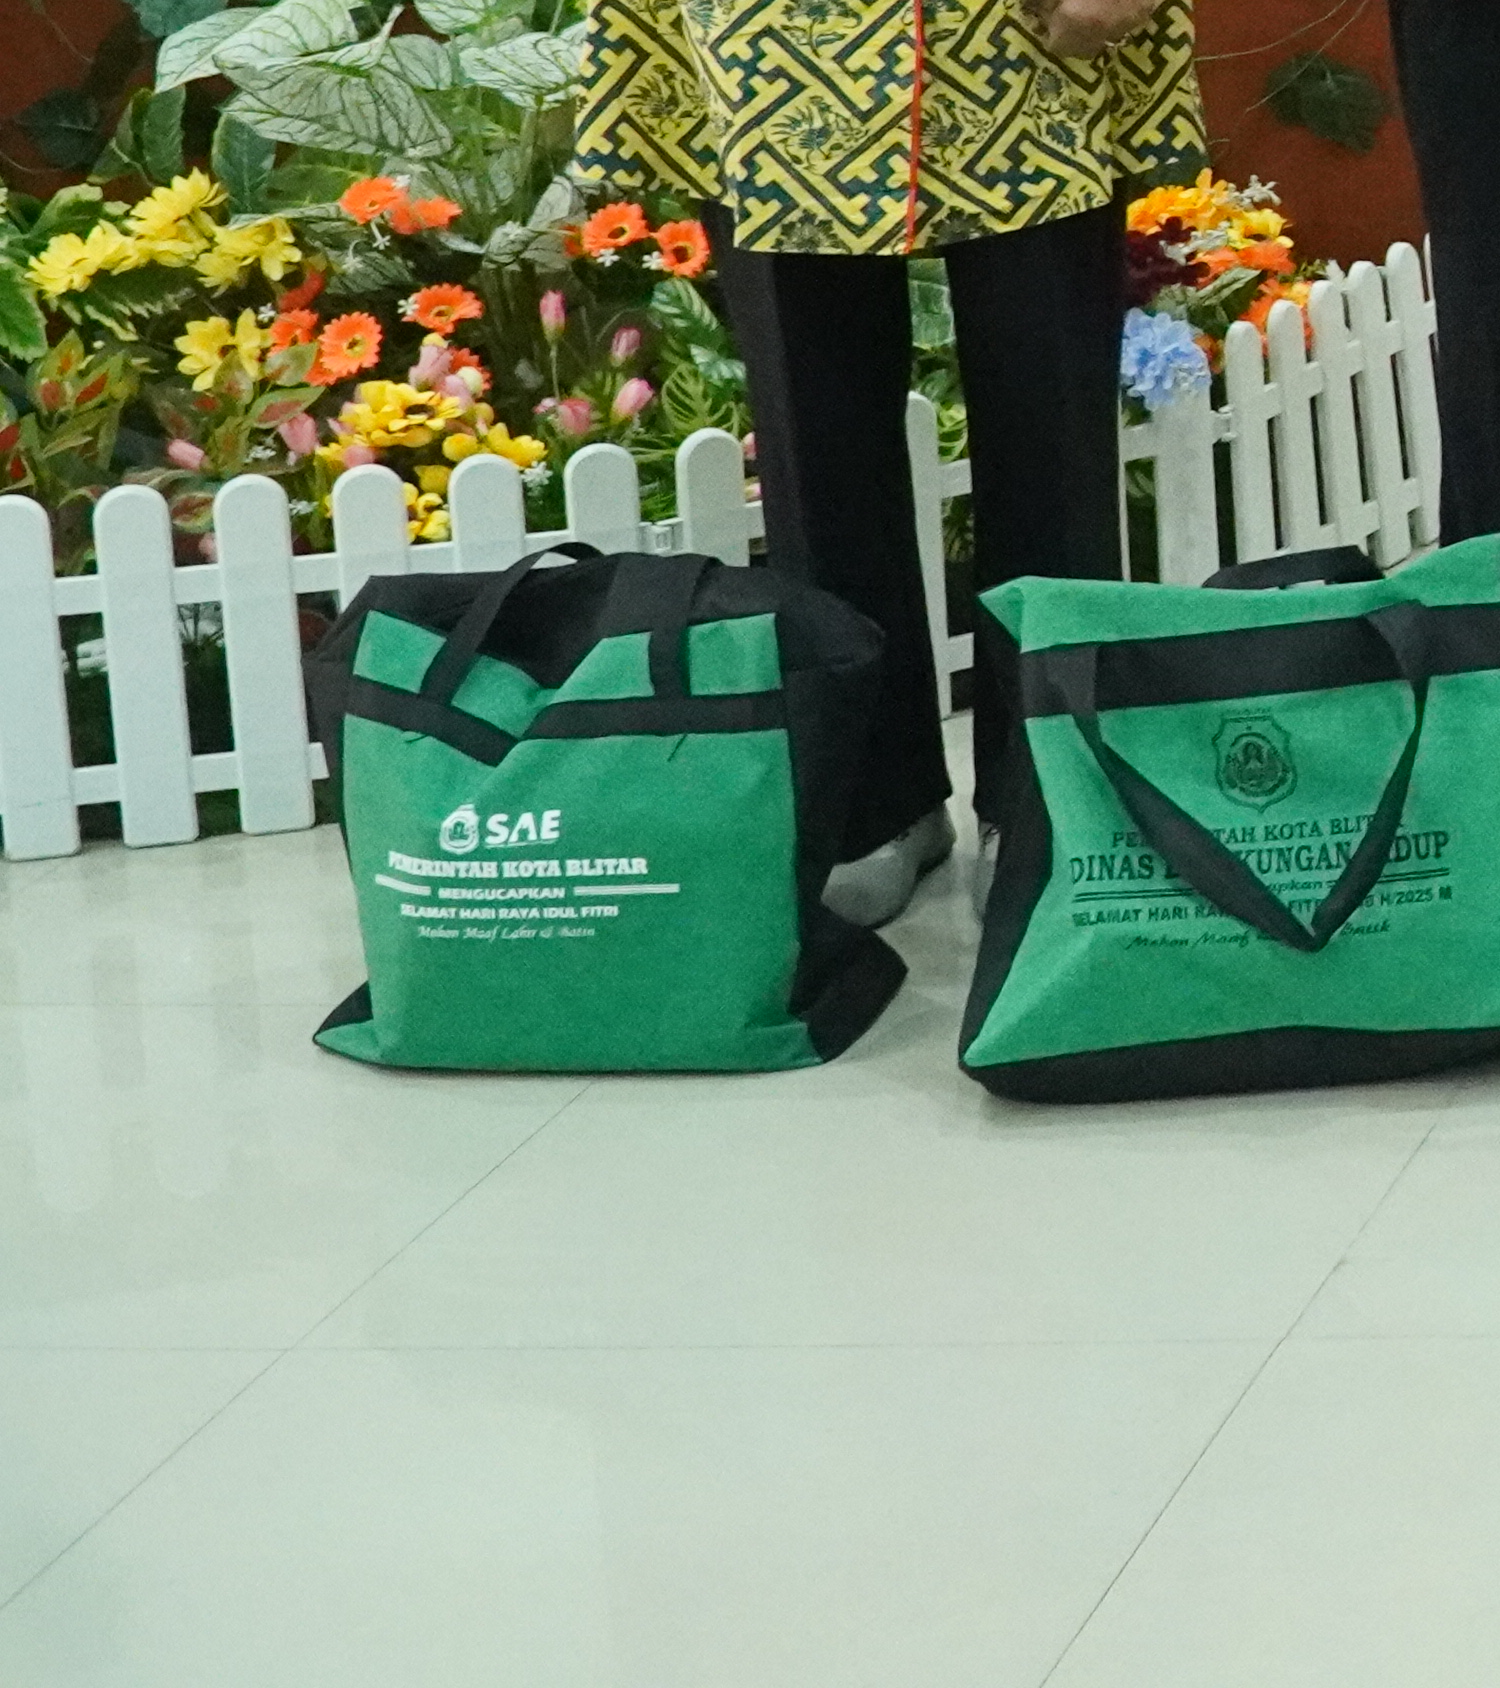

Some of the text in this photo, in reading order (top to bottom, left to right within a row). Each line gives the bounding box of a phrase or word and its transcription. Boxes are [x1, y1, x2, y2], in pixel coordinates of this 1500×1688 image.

[485, 809, 561, 845] SAE
[1264, 821, 1323, 841] KOTA
[1069, 853, 1154, 884] DINAS
[1388, 830, 1450, 863] DUP
[502, 860, 562, 878] KOTA
[565, 858, 648, 877] BLITAR
[437, 887, 566, 900] MENGUCAPKAN
[400, 903, 619, 919] SELAMAT HARI RAYA IDUL FITRI
[1072, 908, 1142, 926] SELAMAT
[1148, 906, 1188, 922] HARI
